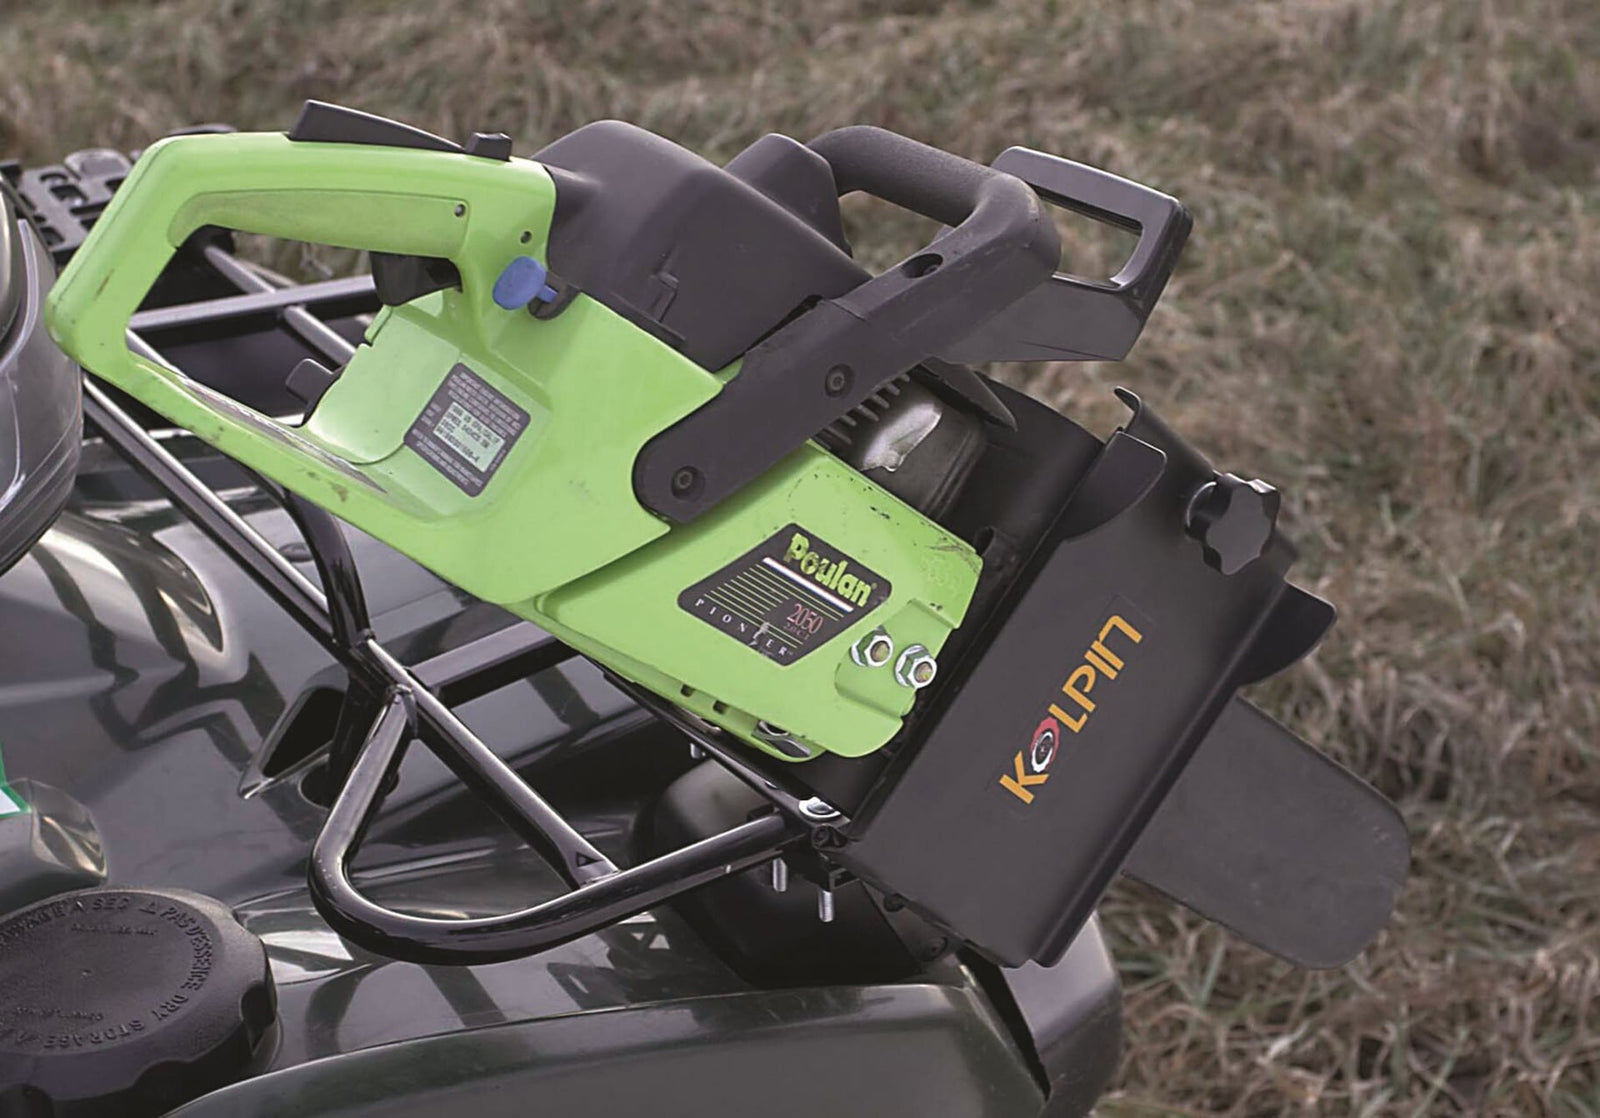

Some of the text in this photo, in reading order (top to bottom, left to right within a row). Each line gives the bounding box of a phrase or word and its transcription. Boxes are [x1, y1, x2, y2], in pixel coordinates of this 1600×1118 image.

[783, 532, 872, 607] Poulan
[786, 602, 824, 635] 2050
[43, 994, 188, 1049] DRY STORAGE
